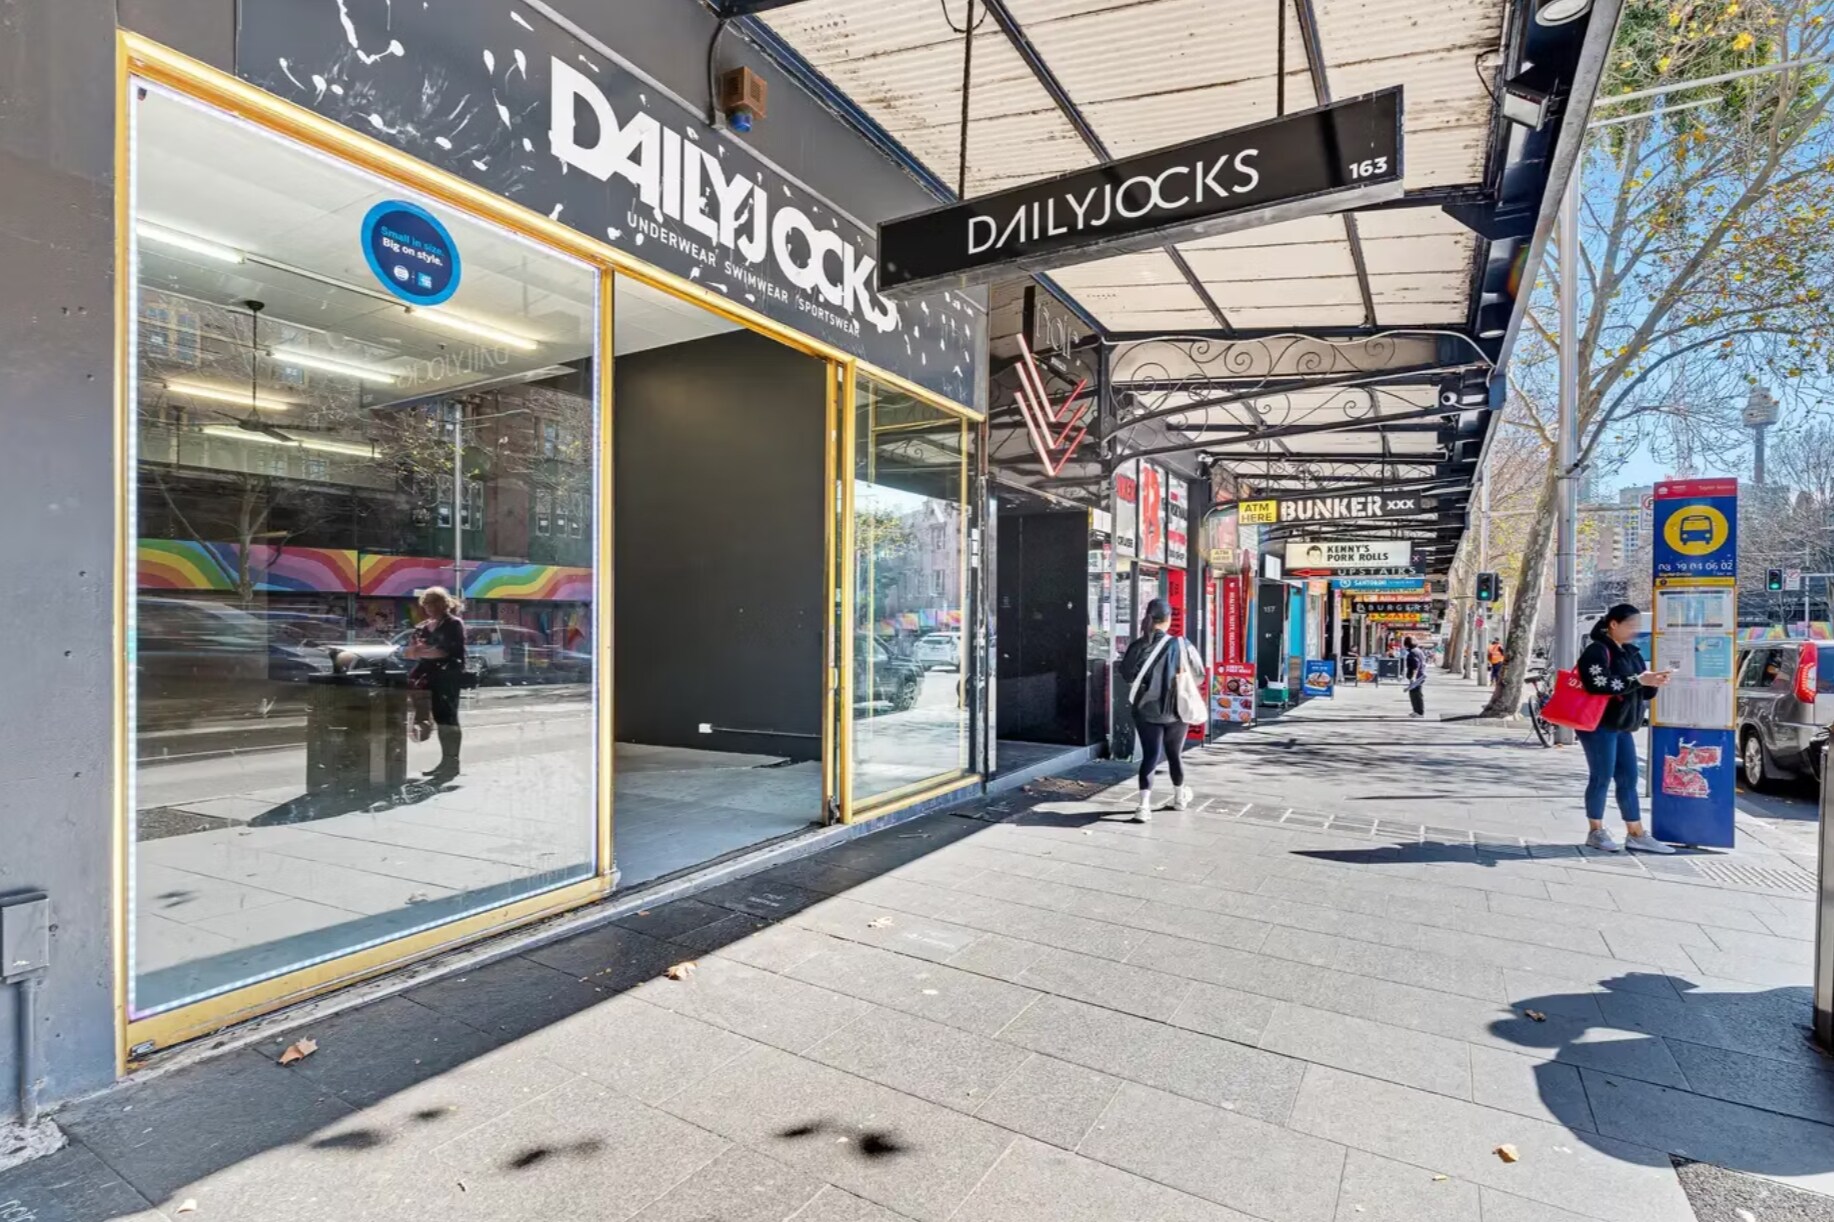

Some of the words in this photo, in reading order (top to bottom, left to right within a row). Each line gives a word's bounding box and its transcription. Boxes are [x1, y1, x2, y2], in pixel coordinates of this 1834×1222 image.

[1349, 156, 1388, 180] 163
[967, 148, 1260, 255] DAILYJOCKS
[380, 226, 410, 245] Small
[412, 237, 422, 248] in
[424, 242, 445, 257] size.
[382, 236, 401, 253] Big
[402, 246, 415, 257] on
[416, 250, 444, 267] style.
[627, 211, 717, 267] UNDERWEAR
[724, 262, 789, 304] SWIMWEAR
[798, 297, 861, 338] SPORTSWEAR
[1241, 512, 1272, 522] HERE
[1244, 503, 1269, 512] ATM
[1280, 496, 1383, 522] BUNKER
[1327, 544, 1370, 554] KENNY'S
[1327, 553, 1355, 562] PORK
[1358, 552, 1389, 561] ROLLS
